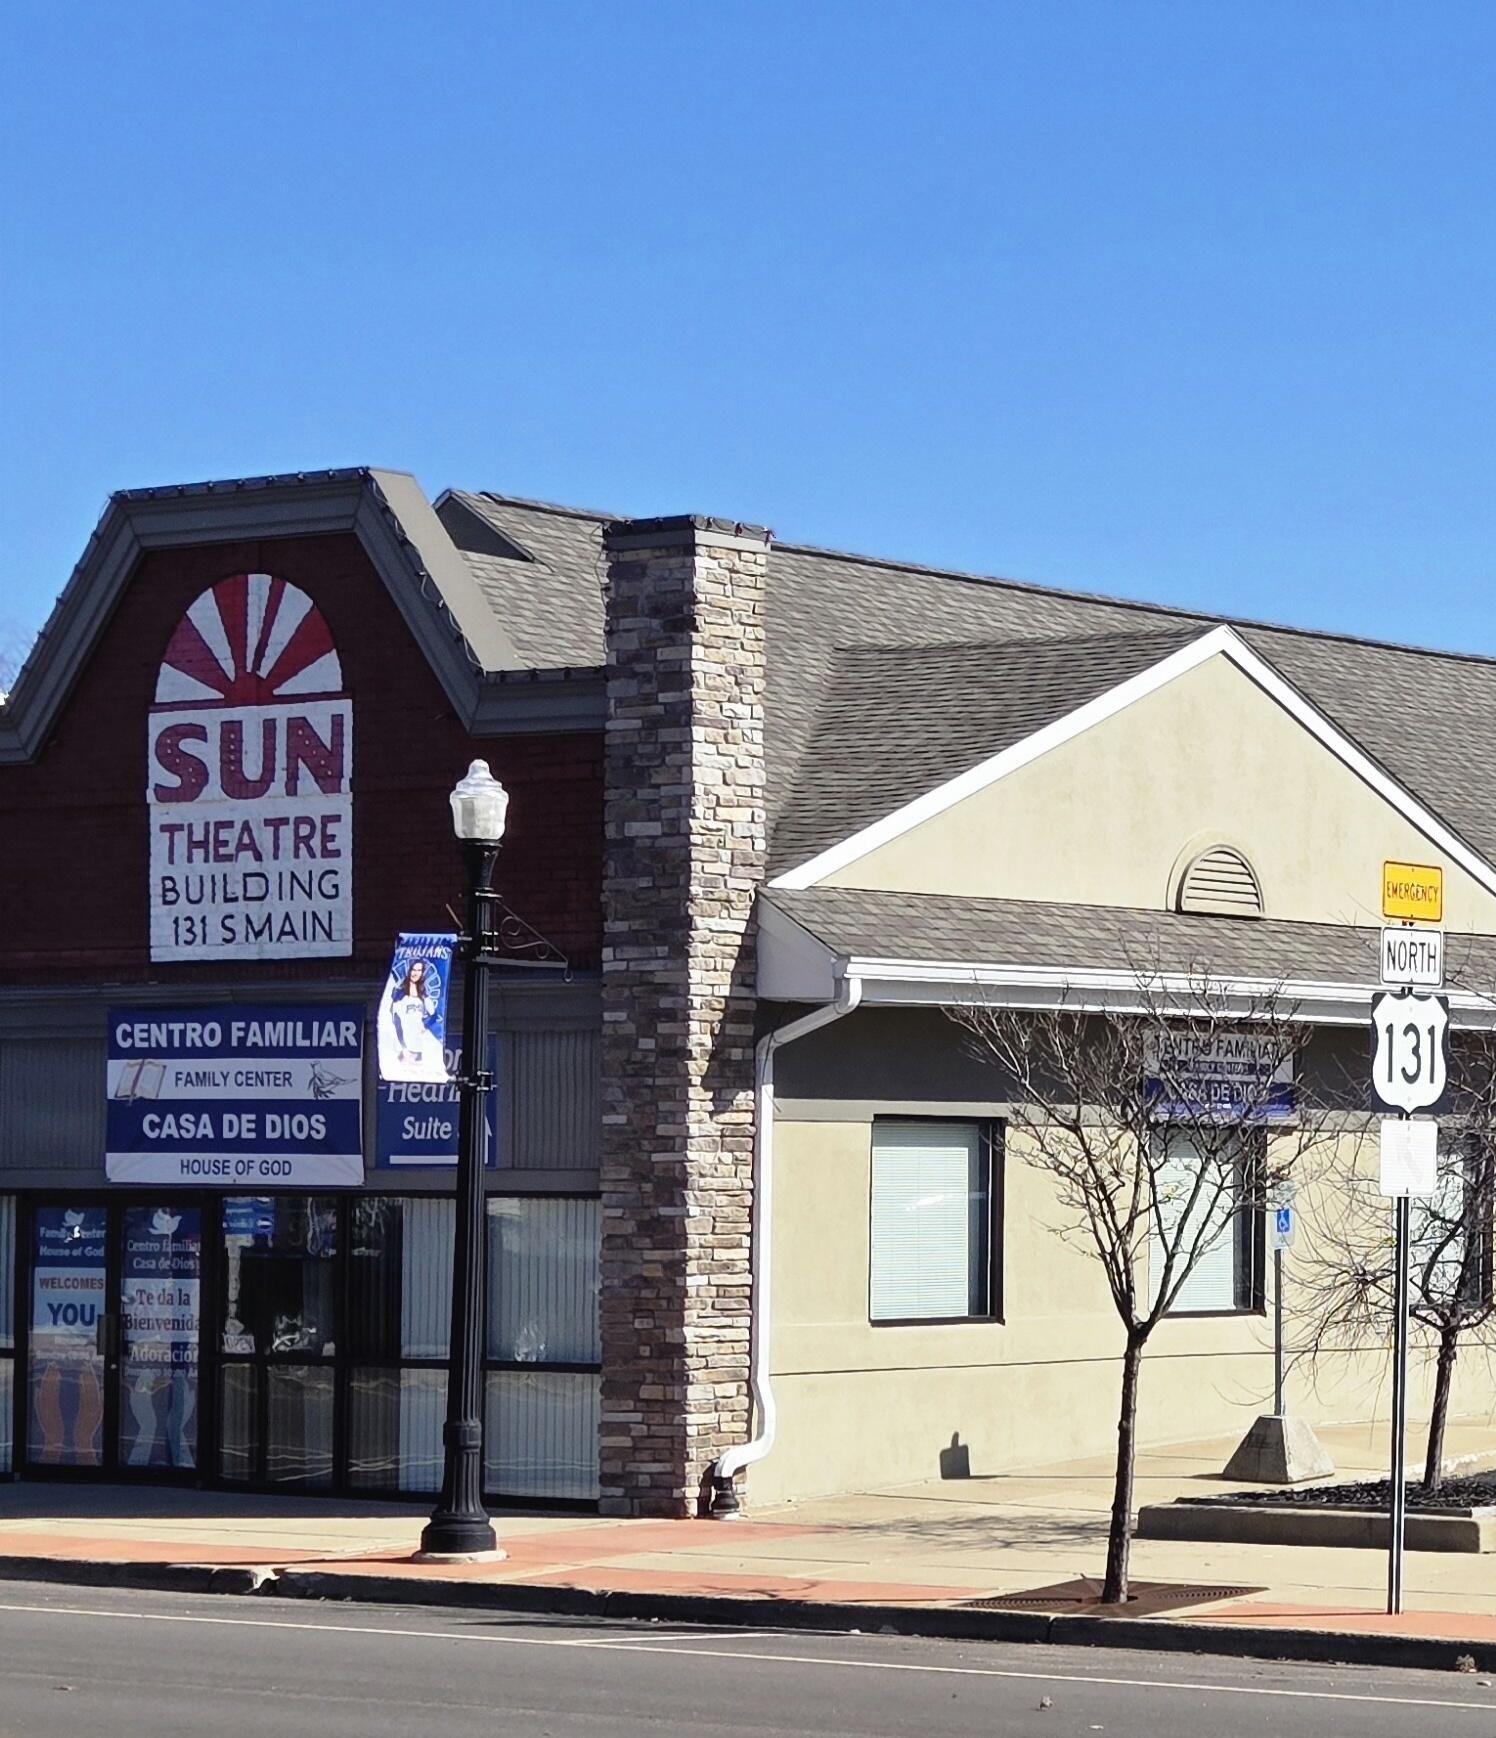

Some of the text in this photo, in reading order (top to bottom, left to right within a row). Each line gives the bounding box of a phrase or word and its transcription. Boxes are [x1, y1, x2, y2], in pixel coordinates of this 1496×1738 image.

[154, 714, 344, 803] SUN
[160, 814, 342, 864] THEATRE
[161, 869, 340, 906] BUILDING
[1387, 881, 1439, 903] EMERGENCY
[173, 911, 333, 946] 131 S MAIN
[1387, 941, 1437, 973] NORTH
[116, 1021, 358, 1048] CENTRO FAMILIAR
[1386, 1023, 1435, 1084] 131
[175, 1071, 293, 1087] FAMILY CENTER
[1212, 1082, 1231, 1102] DE
[142, 1113, 327, 1139] CASA DE DIOS
[402, 1116, 452, 1140] Suite
[181, 1159, 292, 1176] HOUSE OF GOD
[73, 1226, 106, 1239] enter
[40, 1246, 105, 1257] House of God
[127, 1240, 159, 1252] Centro
[133, 1257, 195, 1269] Casa de Dios
[39, 1277, 104, 1290] WELCOMES
[136, 1288, 191, 1306] Te da la
[47, 1302, 96, 1326] YOU
